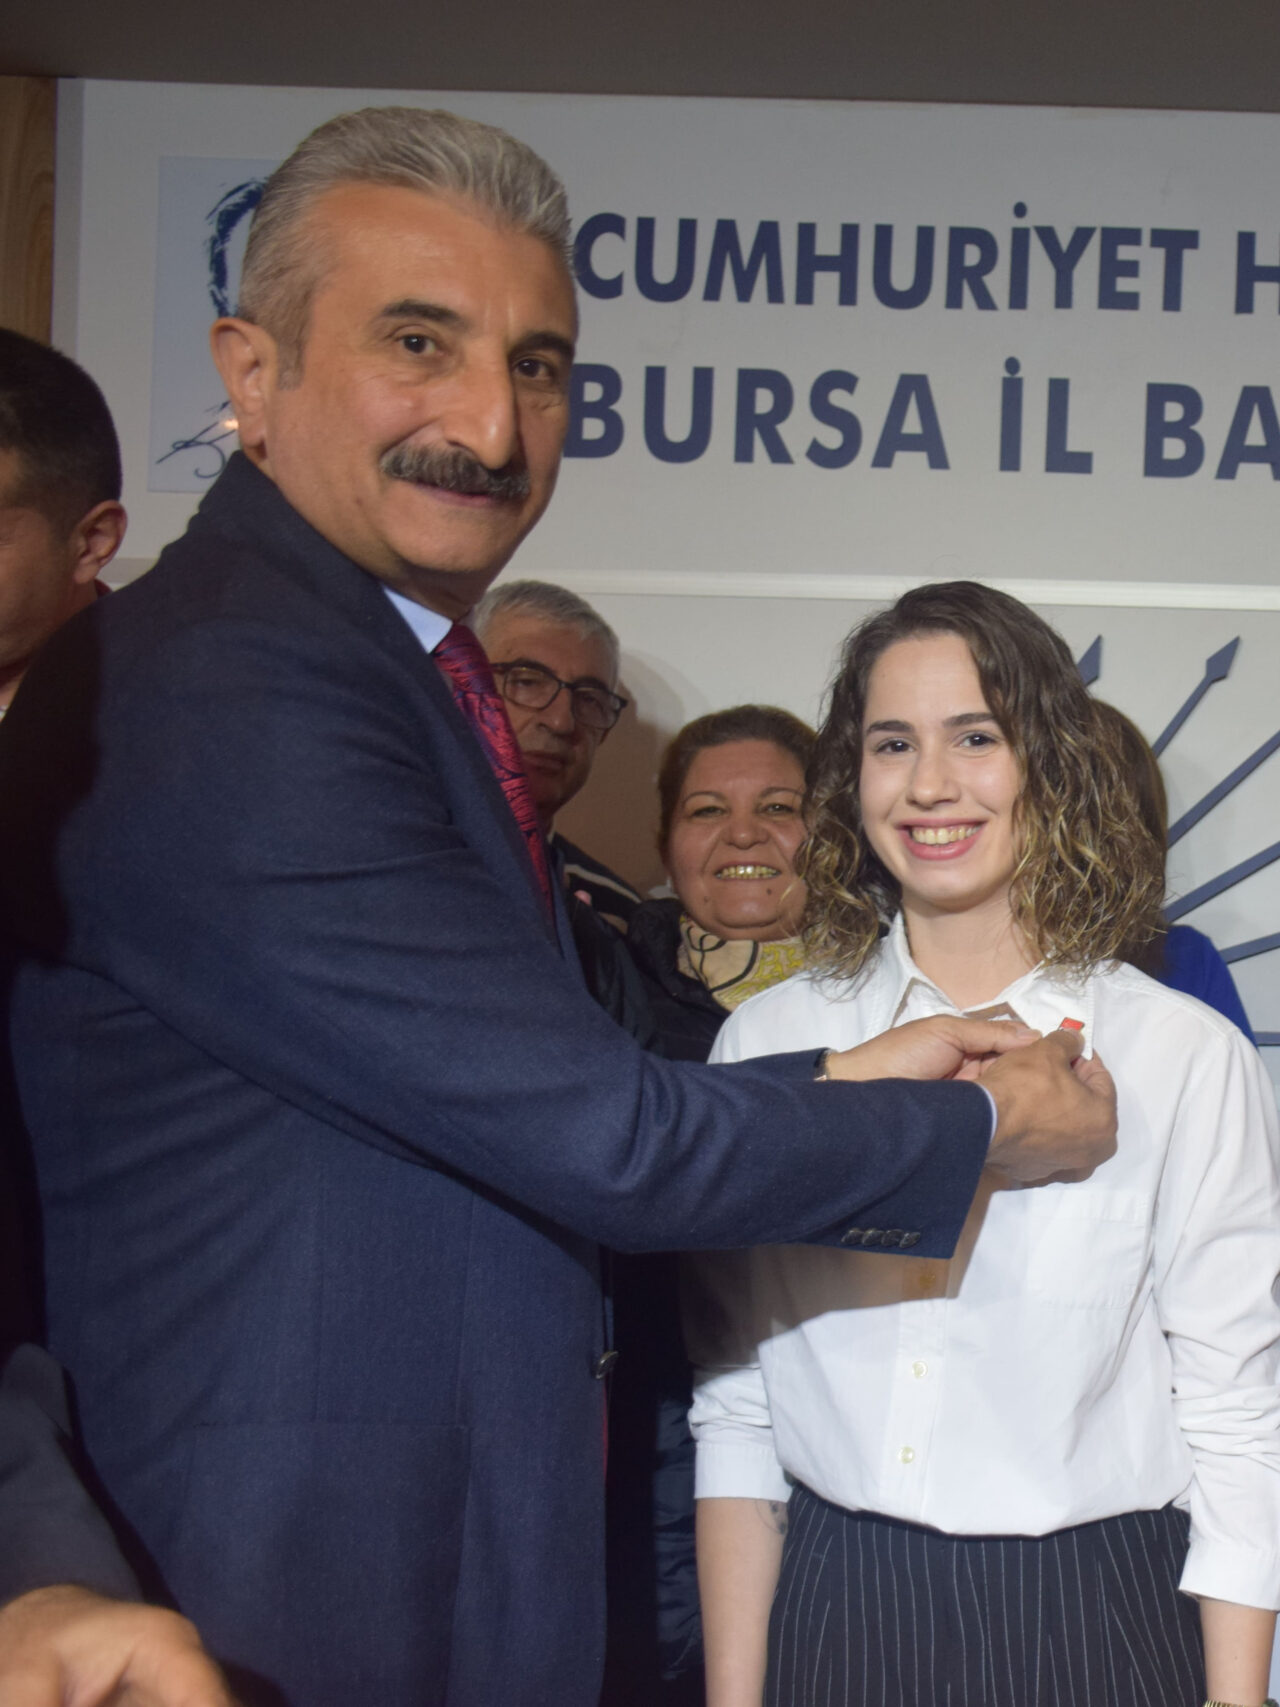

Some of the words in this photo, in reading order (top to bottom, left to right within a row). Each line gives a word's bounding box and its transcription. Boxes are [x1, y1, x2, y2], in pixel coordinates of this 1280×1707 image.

[573, 201, 1200, 312] CUMHURİYET
[562, 363, 951, 470] BURSA
[999, 356, 1094, 475] İL
